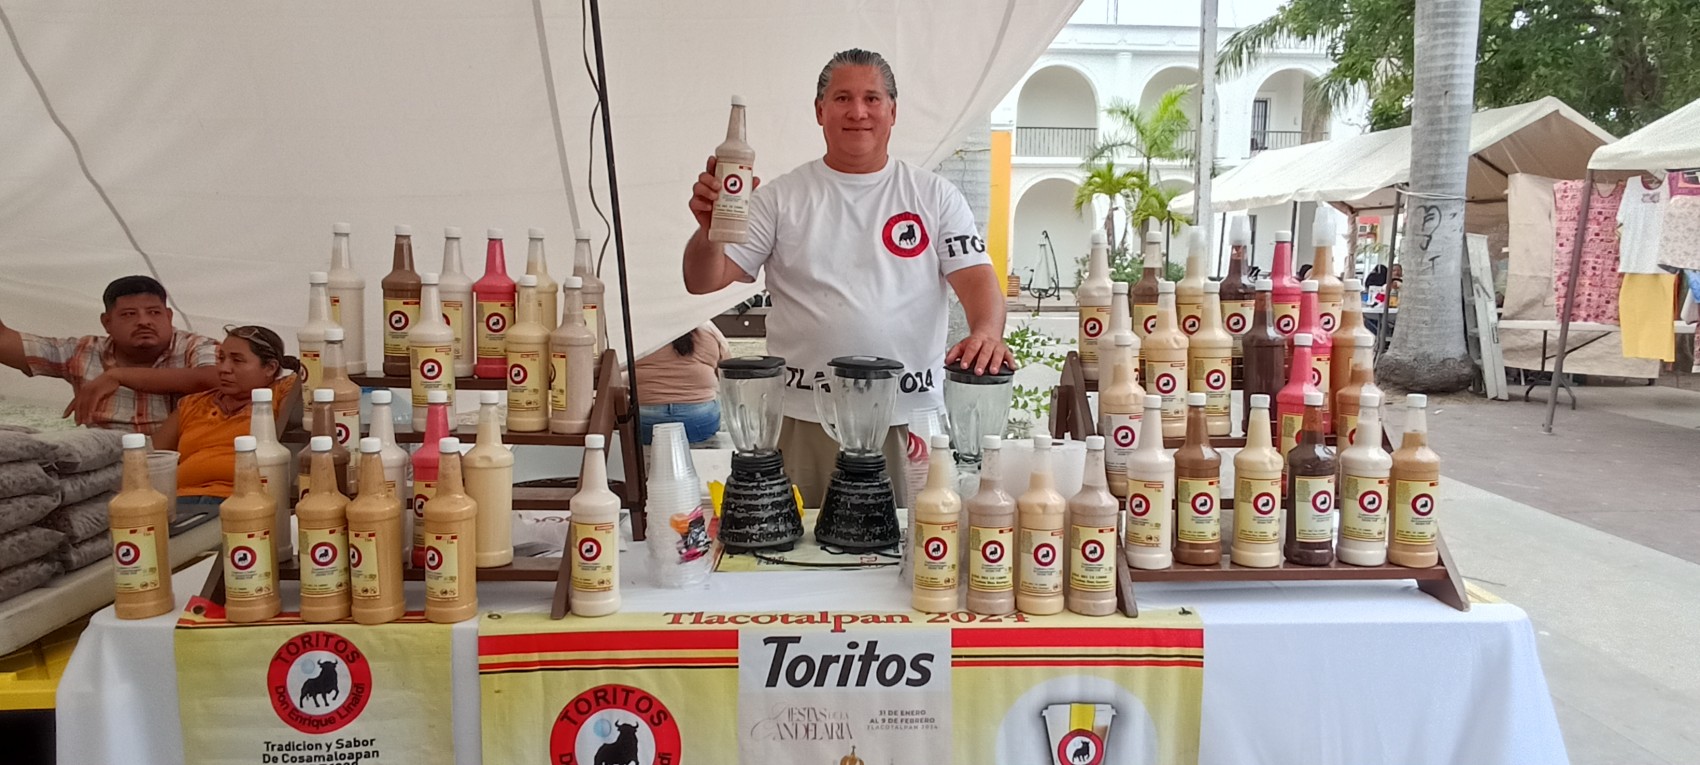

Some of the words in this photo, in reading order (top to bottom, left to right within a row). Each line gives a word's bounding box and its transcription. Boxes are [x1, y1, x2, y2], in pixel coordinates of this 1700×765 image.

[663, 611, 913, 633] Tlacotalpan
[925, 611, 1031, 624] 2024
[274, 633, 361, 665] TORITOS
[762, 635, 935, 689] Toritos
[275, 685, 290, 711] Don
[287, 706, 337, 731] Enrique
[336, 682, 366, 721] Linaldi
[559, 687, 669, 728] TORITOS
[887, 709, 899, 717] DE
[900, 709, 927, 717] ENERO
[262, 753, 279, 764] De
[281, 750, 380, 764] Cosamaloapan
[263, 741, 323, 752] Tradicion
[325, 742, 332, 752] y
[335, 737, 376, 749] Sabor
